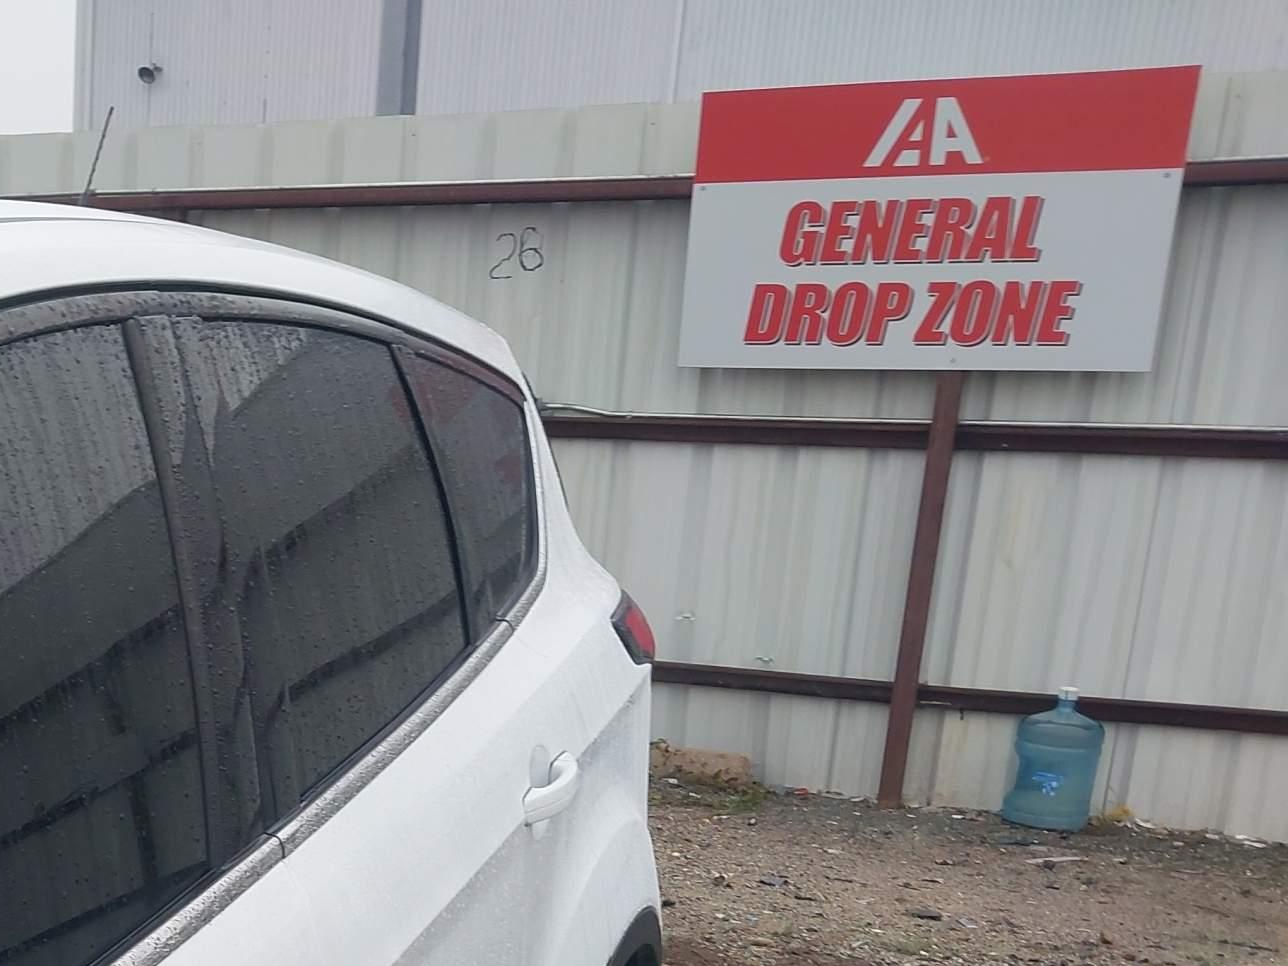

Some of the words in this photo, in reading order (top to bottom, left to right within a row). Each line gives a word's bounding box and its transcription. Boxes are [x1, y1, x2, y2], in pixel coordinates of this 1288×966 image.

[863, 96, 984, 167] IAA
[489, 226, 544, 279] 26
[779, 195, 1045, 267] GENERAL
[743, 282, 914, 347] DROP
[912, 280, 1083, 348] ZONE
